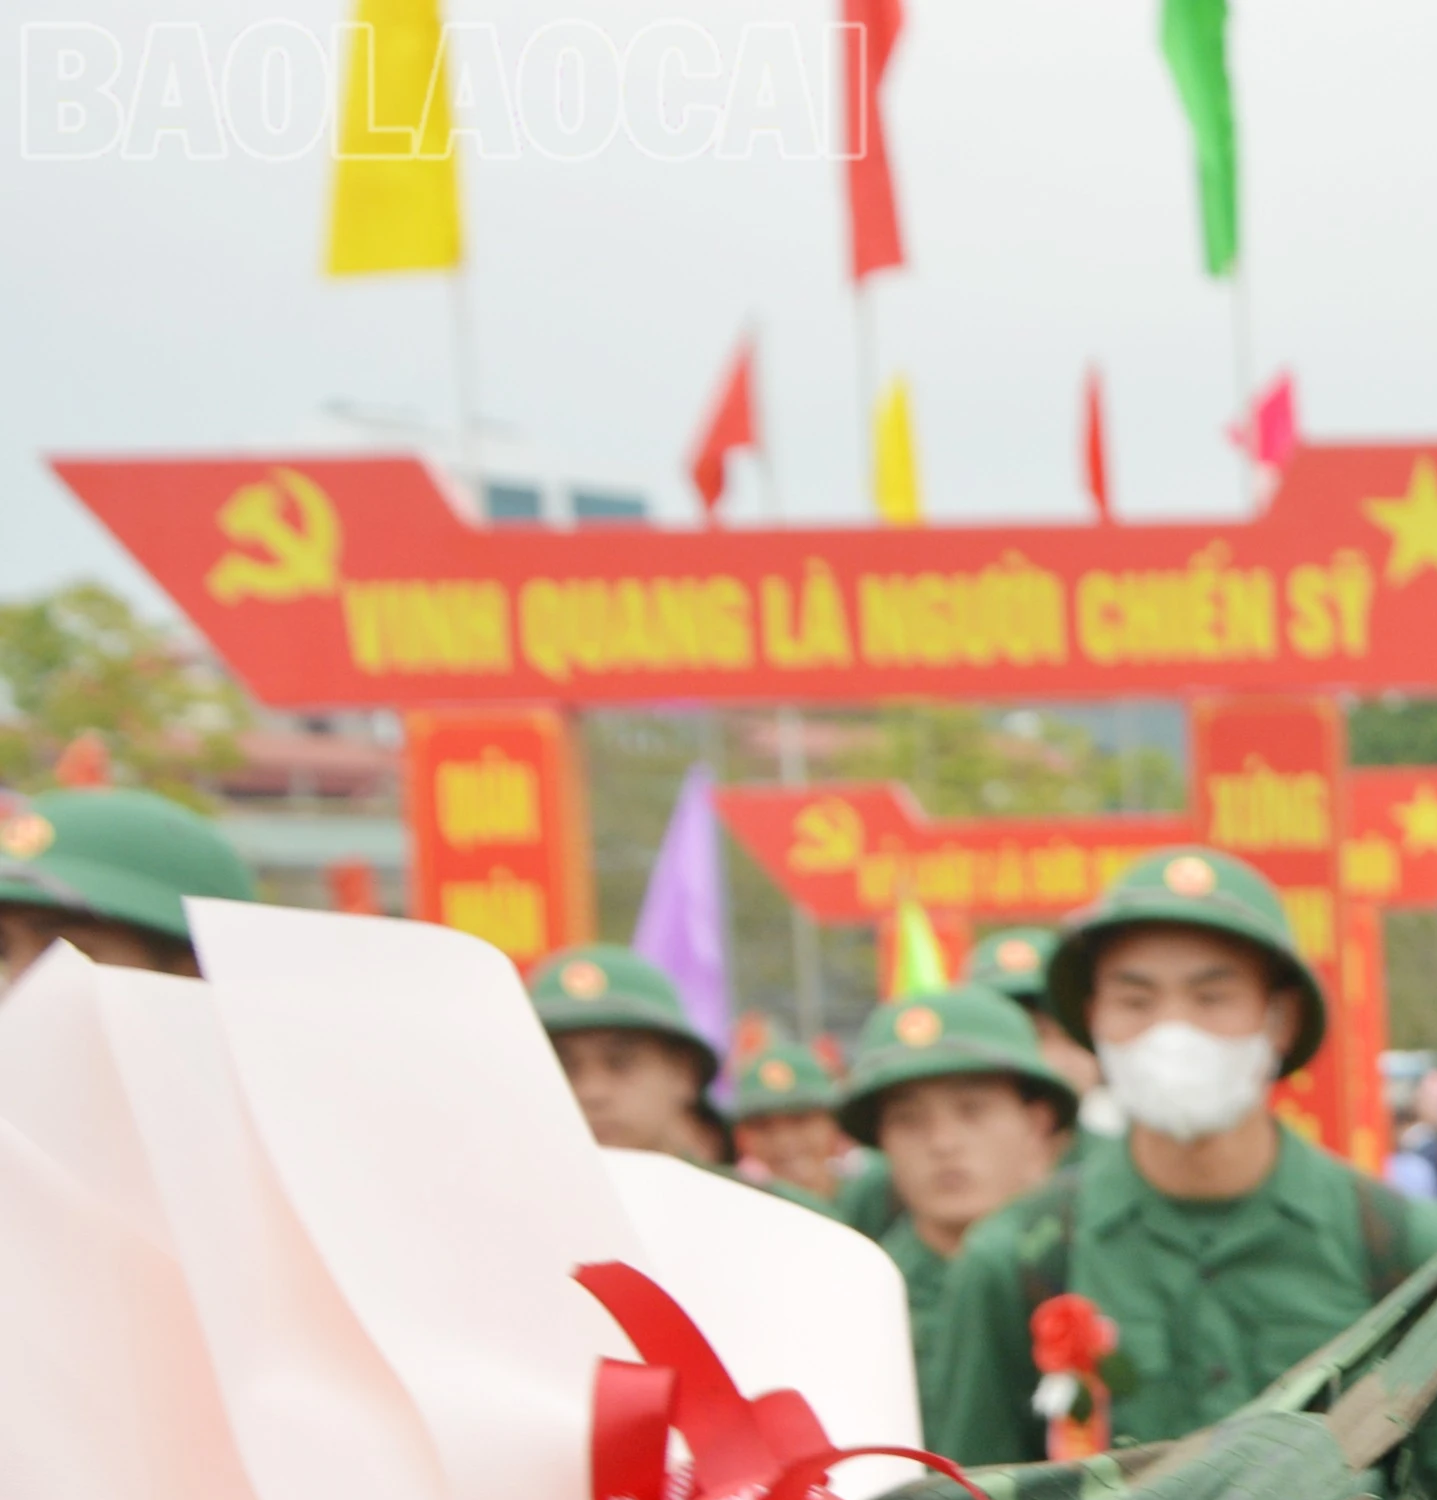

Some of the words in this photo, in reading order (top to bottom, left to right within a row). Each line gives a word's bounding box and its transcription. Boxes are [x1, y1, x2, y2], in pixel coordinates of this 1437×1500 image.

[346, 578, 511, 673] VINH
[519, 576, 754, 682] QUANG
[762, 558, 852, 668] LÀ
[858, 549, 1067, 665] NGƯỜI
[1077, 540, 1278, 663] CHIẾN
